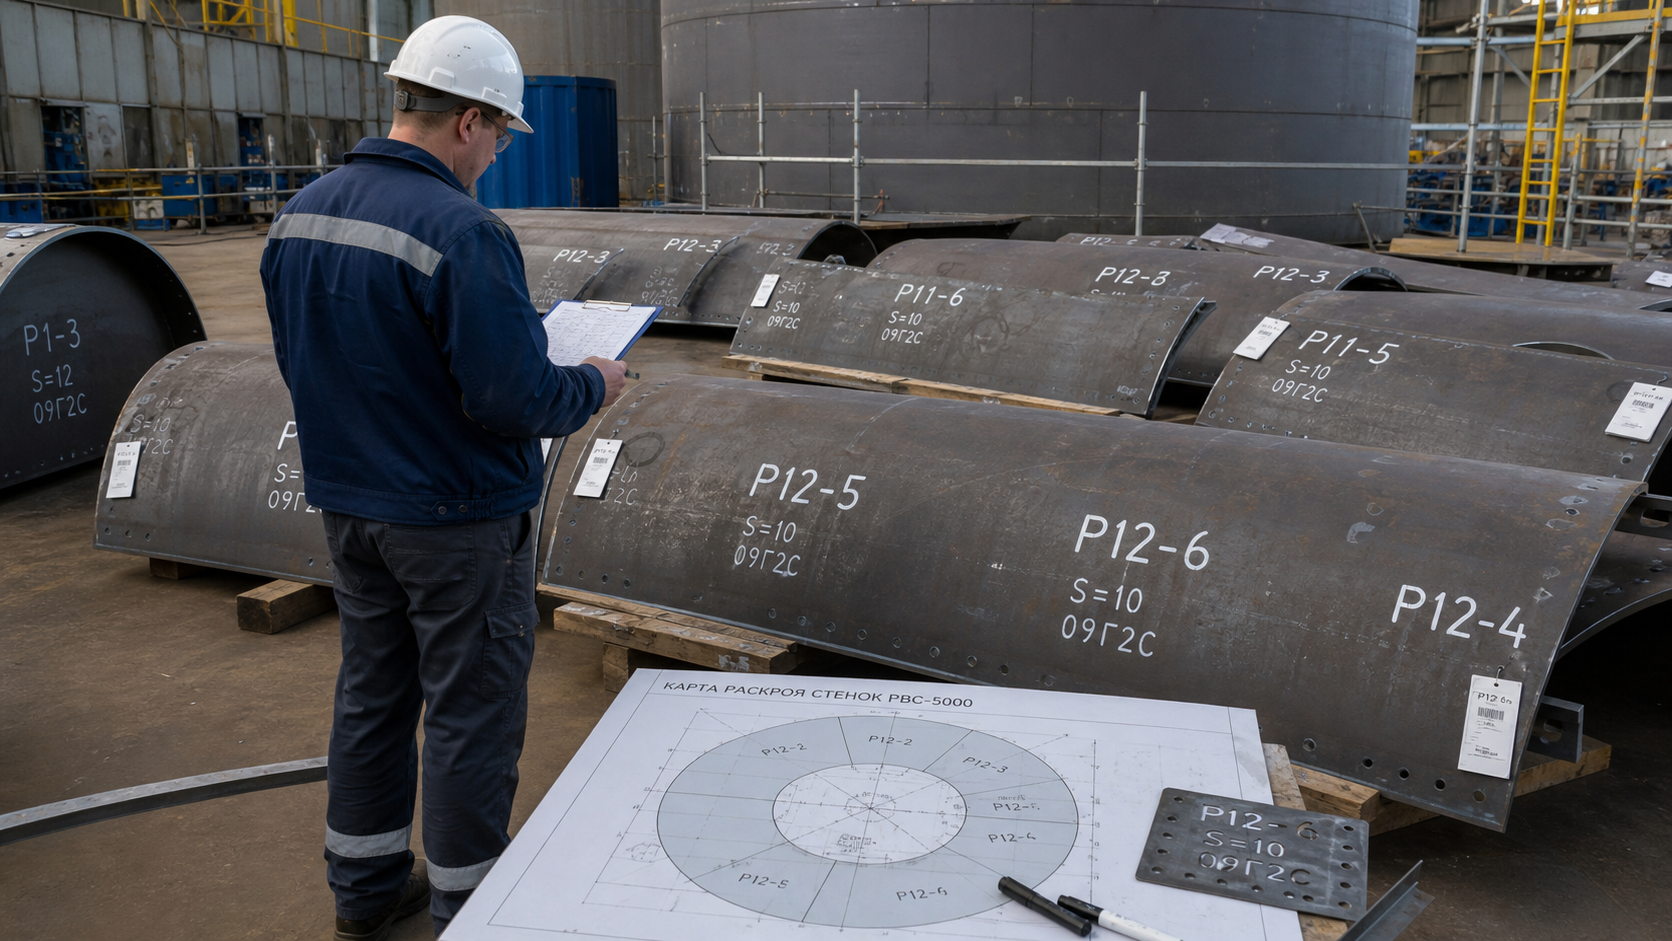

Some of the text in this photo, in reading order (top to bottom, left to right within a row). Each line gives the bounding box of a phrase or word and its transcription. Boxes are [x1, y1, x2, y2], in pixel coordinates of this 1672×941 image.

[552, 249, 611, 264] Р12-3
[1253, 265, 1331, 284] Р12-3
[773, 301, 800, 314] S=10
[894, 283, 967, 307] Р11-6
[888, 311, 922, 326] S=10
[23, 318, 81, 356] Р1-3
[881, 328, 924, 344] 09Г2С
[1298, 329, 1400, 365] Р11-5
[31, 364, 74, 393] S=12
[1285, 359, 1331, 380] S=10
[1271, 378, 1328, 403] 09Г2С
[33, 393, 88, 424] 09Г2С
[748, 462, 867, 511] Р12-5
[742, 515, 797, 543] S=10
[1074, 514, 1211, 571] Р12-6
[734, 544, 801, 577] 09Г2С
[1069, 577, 1143, 613] S=10
[1391, 584, 1527, 649] Р12-4
[1061, 614, 1156, 657] 09Г2С
[663, 681, 974, 708] КАРТА РАСКРОЯ СТЕНОК РВС-5000
[761, 743, 808, 757] Р12-2
[868, 734, 914, 747] Р12-2
[962, 756, 1009, 774] Р12-3
[1203, 830, 1285, 858] S=10
[1198, 852, 1311, 886] 09Г2С
